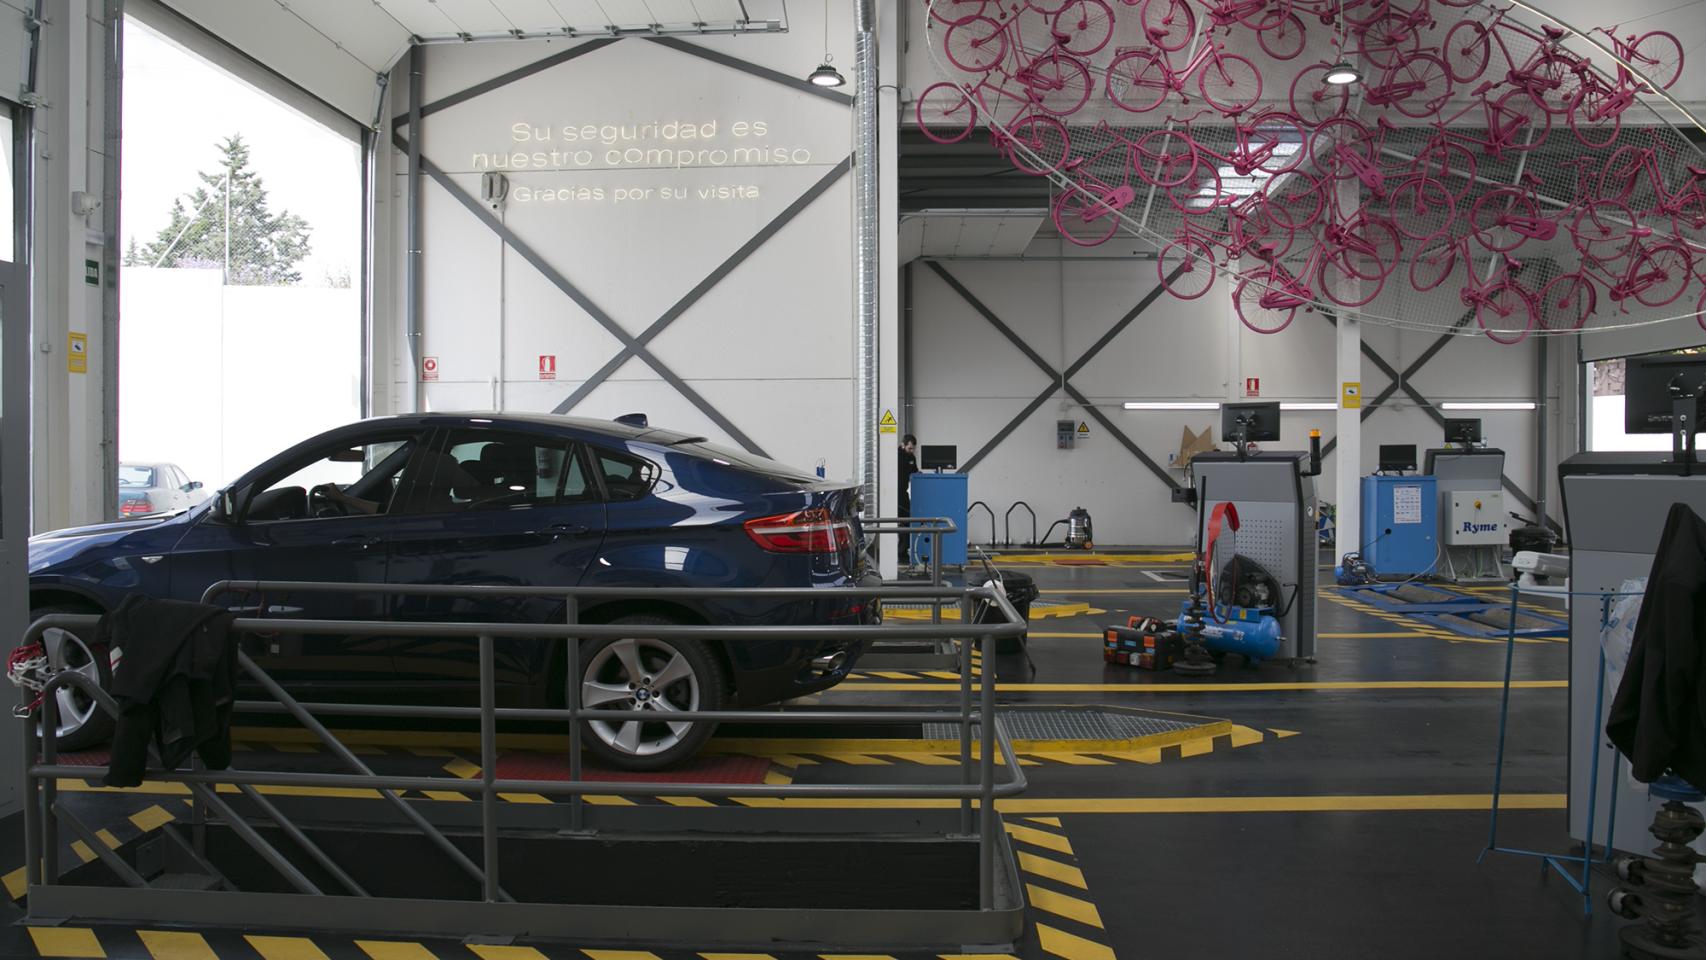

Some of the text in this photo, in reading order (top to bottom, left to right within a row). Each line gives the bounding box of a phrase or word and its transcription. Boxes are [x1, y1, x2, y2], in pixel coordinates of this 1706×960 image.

[511, 119, 768, 145] Su seguridad es
[472, 148, 593, 170] nuestro
[513, 184, 760, 203] Gracias por su visita
[1463, 521, 1498, 534] Ryme
